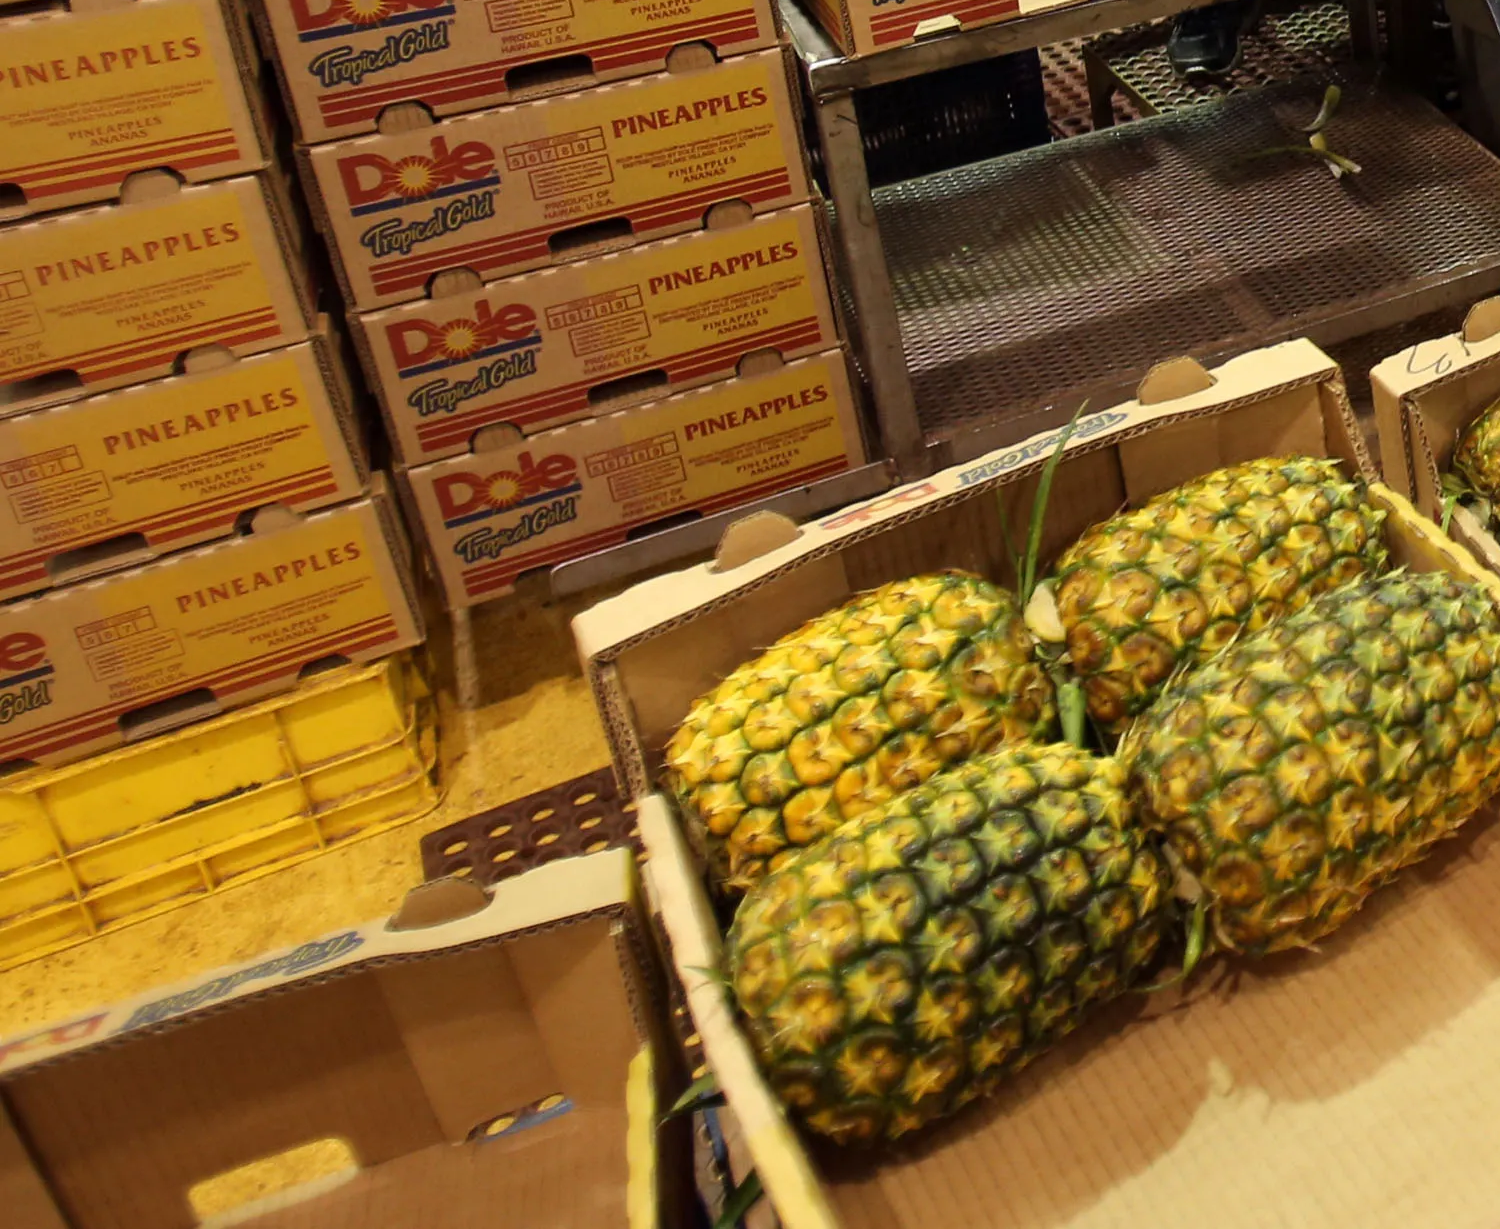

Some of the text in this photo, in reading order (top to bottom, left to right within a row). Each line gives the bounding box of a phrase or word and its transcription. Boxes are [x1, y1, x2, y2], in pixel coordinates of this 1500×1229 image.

[308, 19, 451, 87] Tropical Gold
[610, 86, 768, 138] PINEAPPLES
[333, 135, 494, 209] Dole
[34, 221, 241, 287] PINEAPPLES
[359, 190, 496, 258] Tropical Gold
[647, 240, 799, 295] PINEAPPLES
[384, 298, 536, 371] Dole
[408, 348, 538, 417] Tropical Gold
[683, 383, 829, 441] PINEAPPLES
[102, 387, 299, 456] PINEAPPLES
[430, 451, 576, 522] Dole
[453, 496, 578, 564] Tropical Gold
[175, 541, 362, 614] PINEAPPLES
